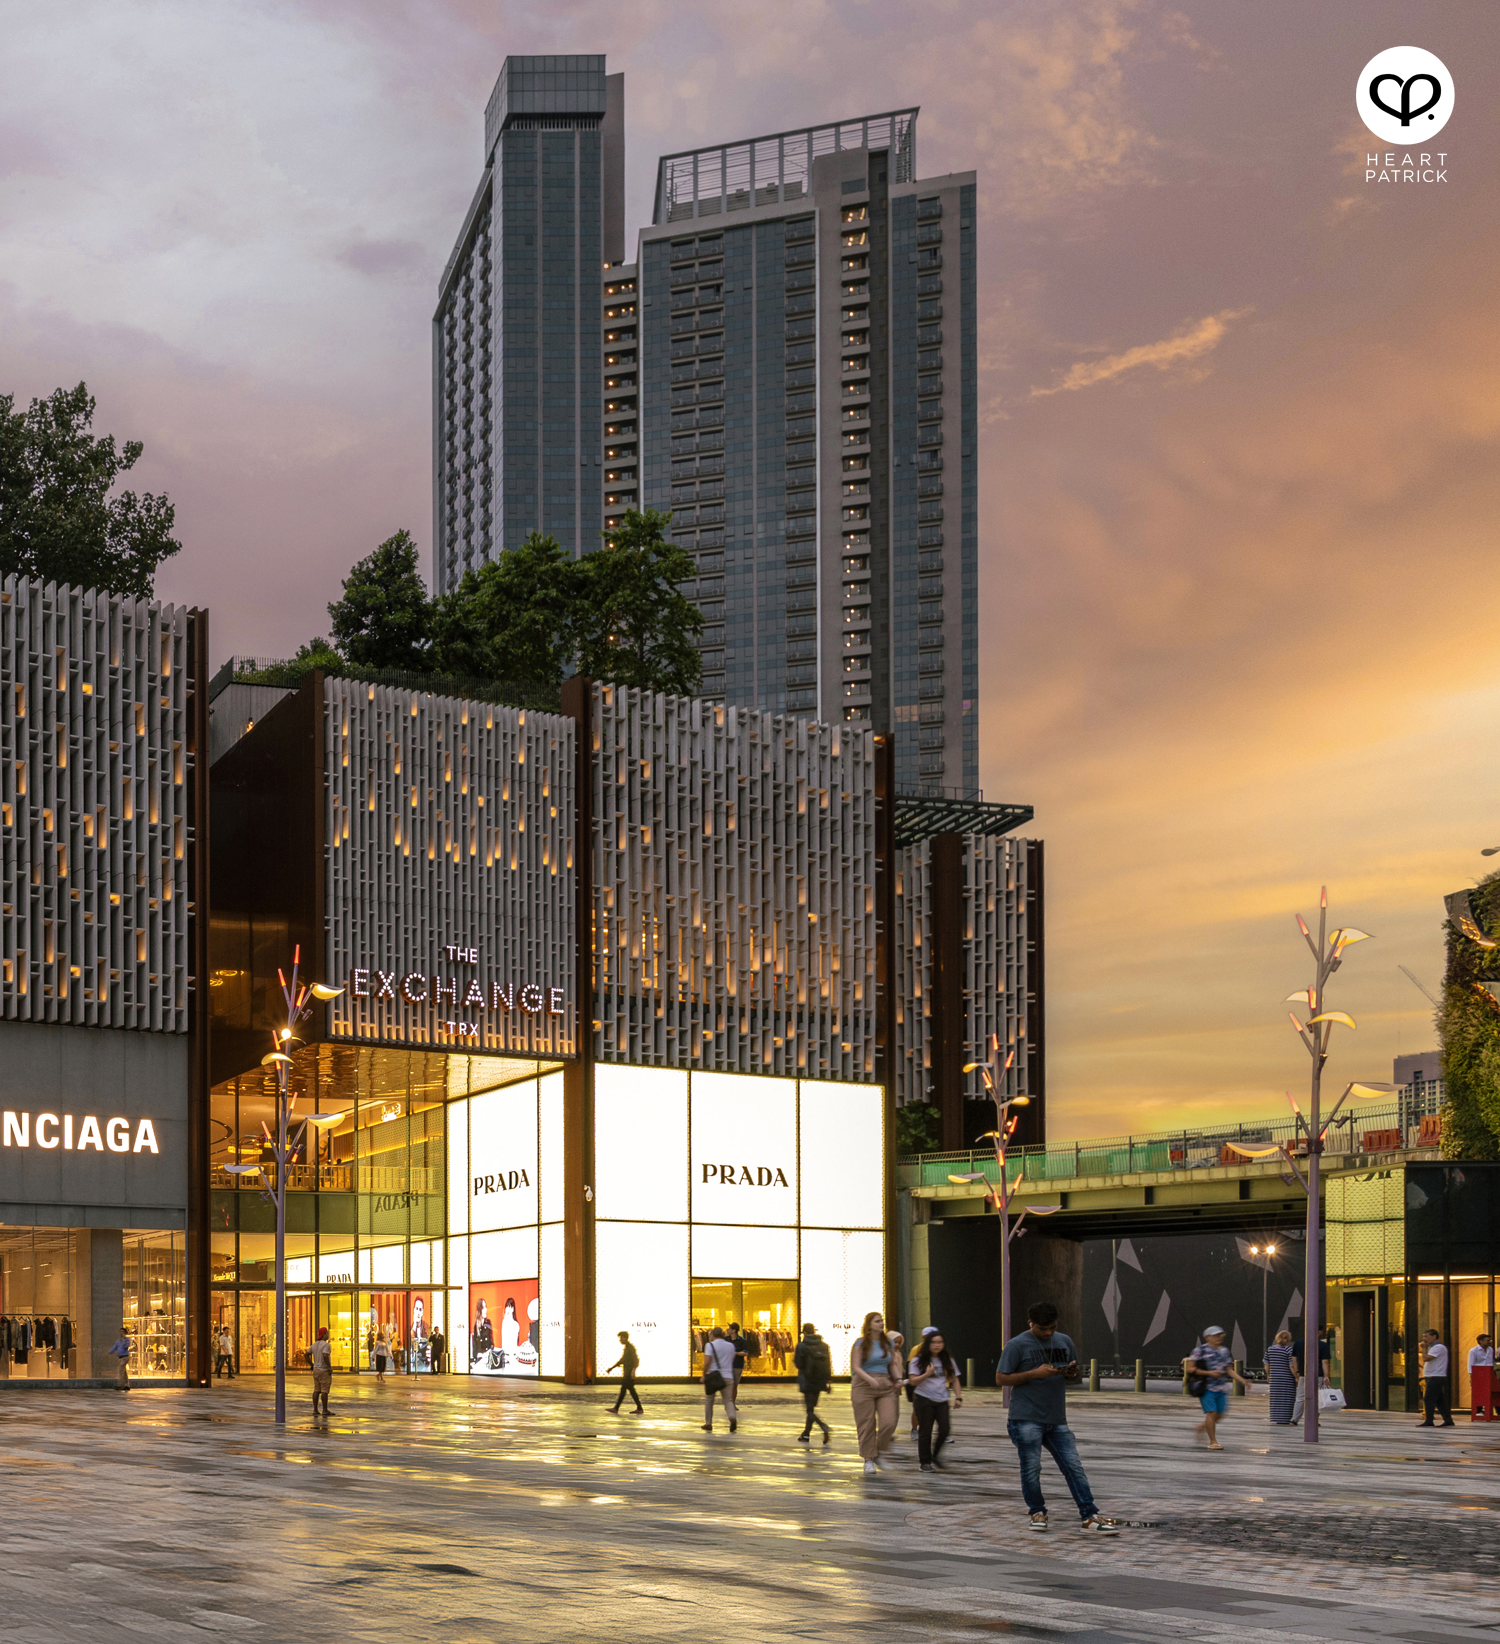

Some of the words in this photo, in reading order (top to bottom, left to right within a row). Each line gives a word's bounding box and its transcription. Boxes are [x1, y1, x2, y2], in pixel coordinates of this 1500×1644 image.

[446, 945, 478, 963] THE
[353, 968, 564, 1014] EXCHANGE
[446, 1021, 479, 1037] TRX
[473, 1168, 530, 1196] PRADA
[702, 1163, 789, 1188] PRADA
[326, 1273, 352, 1283] PRADA
